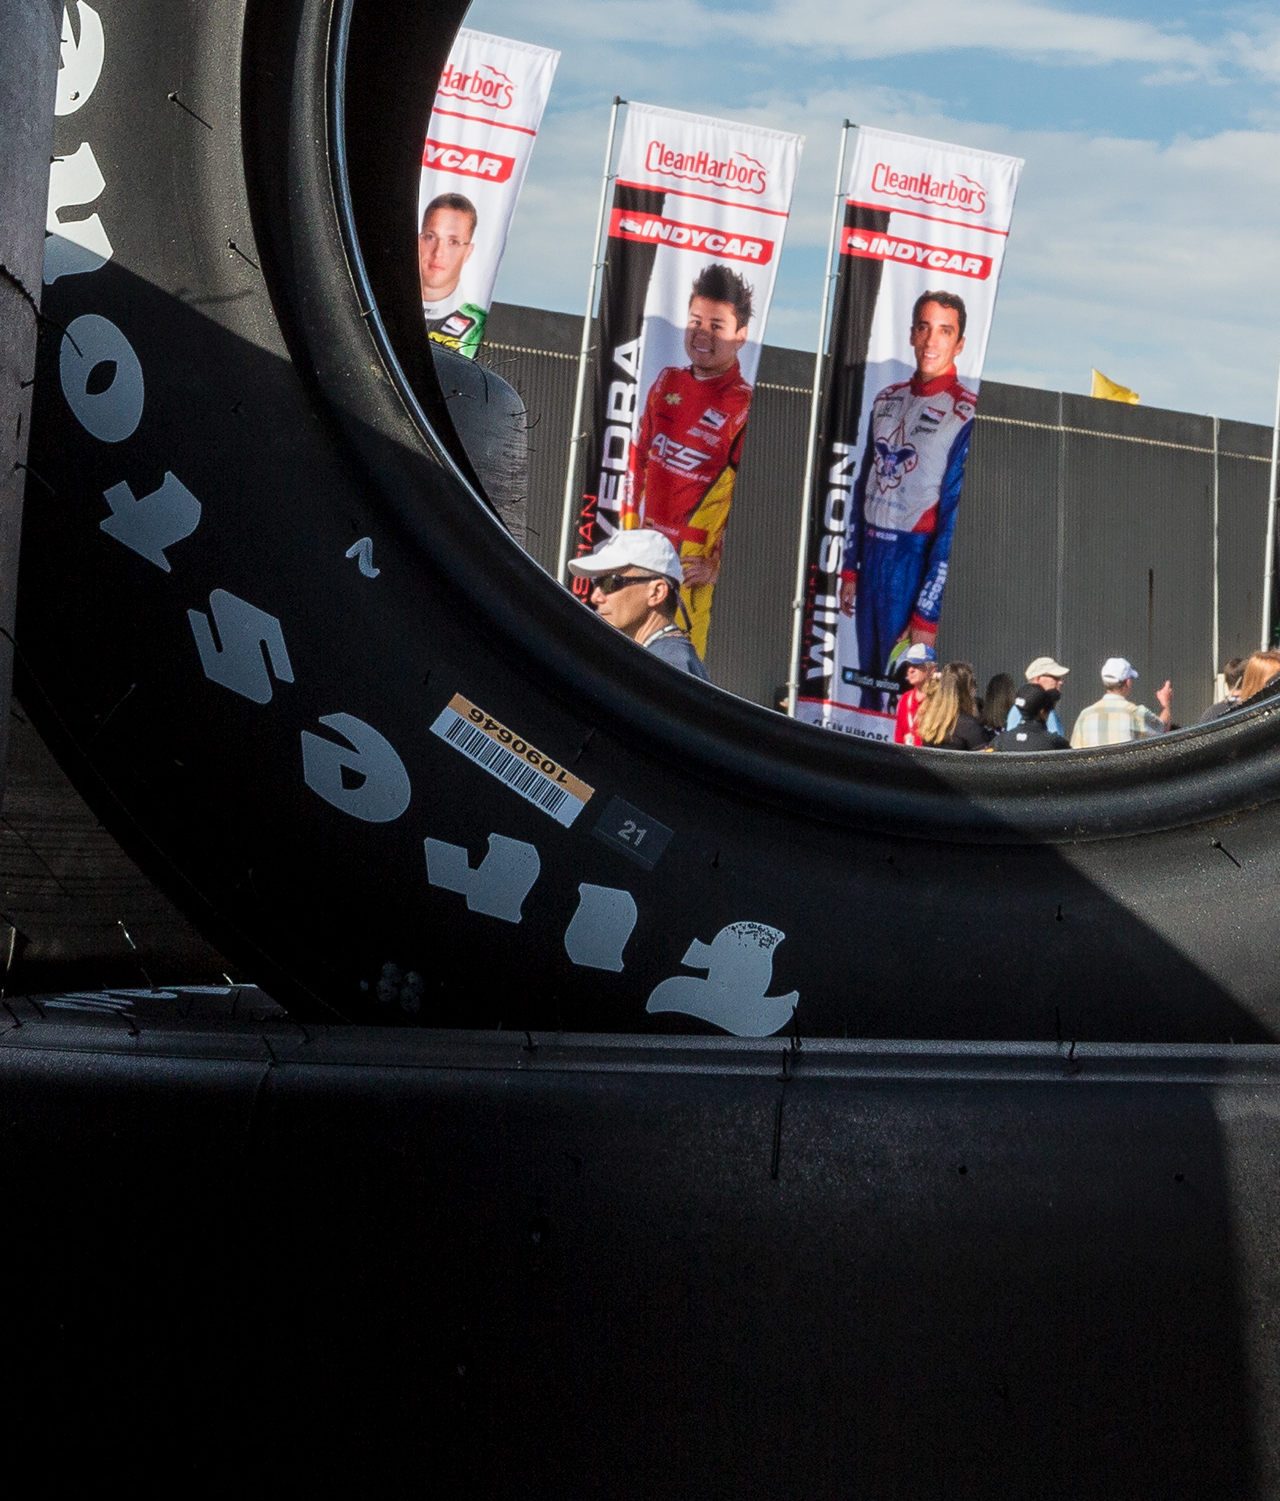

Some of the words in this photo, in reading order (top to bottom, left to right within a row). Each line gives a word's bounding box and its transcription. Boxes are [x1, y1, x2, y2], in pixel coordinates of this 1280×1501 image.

[635, 220, 763, 260] INDYCAR
[868, 237, 983, 275] INDYCAR
[806, 442, 856, 681] WILSON
[468, 706, 568, 785] 1090646
[617, 819, 648, 847] 21
